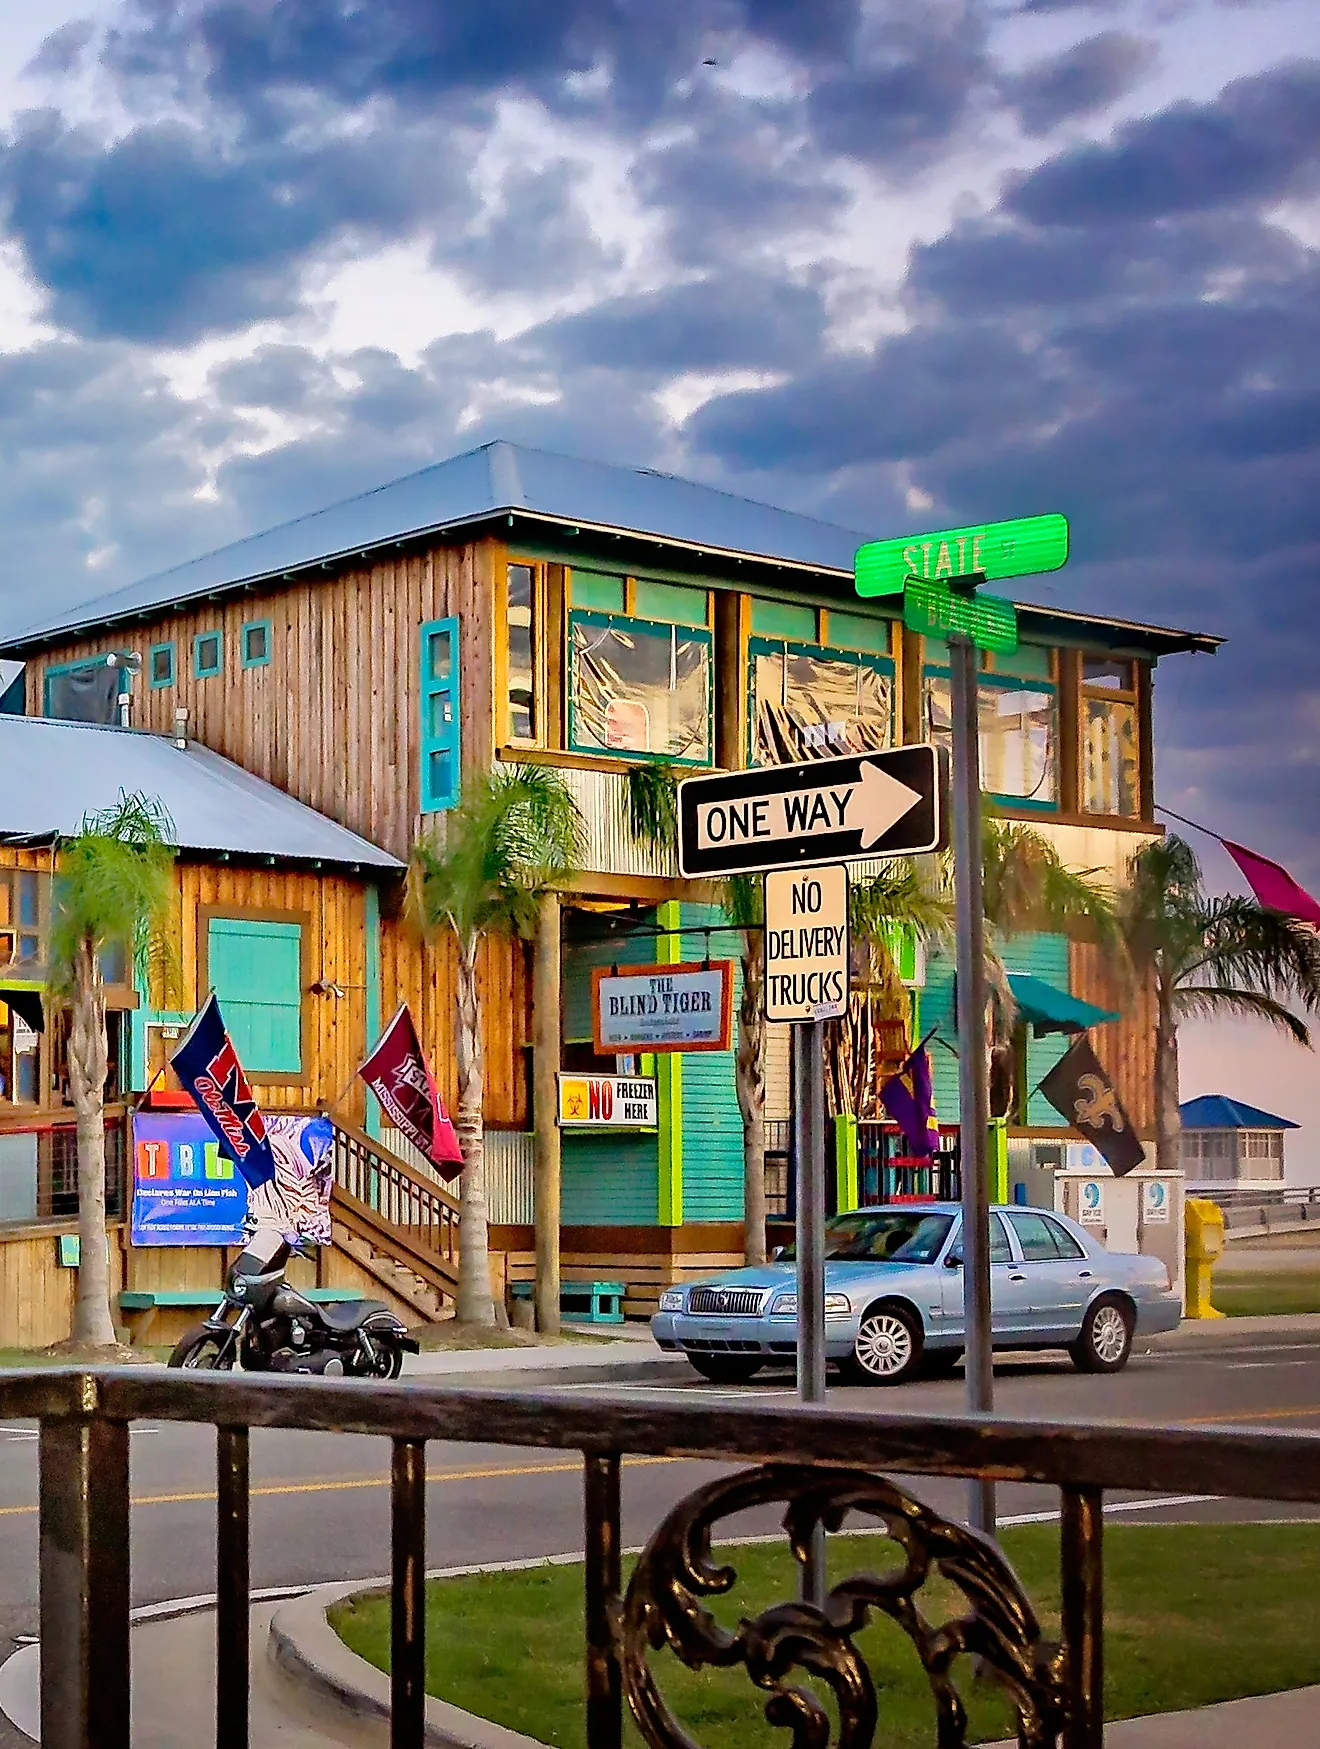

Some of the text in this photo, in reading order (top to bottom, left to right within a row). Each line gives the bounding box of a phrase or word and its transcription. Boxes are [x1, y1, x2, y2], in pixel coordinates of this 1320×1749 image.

[902, 533, 986, 578] STATE
[706, 788, 855, 843] ONE WAY
[792, 881, 822, 914] NO
[768, 925, 845, 960] DELIVERY
[649, 977, 674, 993] THE
[768, 970, 843, 1006] TRUCKS
[609, 990, 712, 1016] BLIND TIGER
[588, 1080, 613, 1121] NO
[617, 1082, 655, 1100] FREEZER
[193, 1076, 251, 1158] Ole Miss
[371, 1076, 420, 1143] MISSISSIPPI
[624, 1102, 649, 1120] HERE
[175, 1188, 192, 1197] War
[192, 1189, 203, 1197] On
[221, 1188, 238, 1198] Fish
